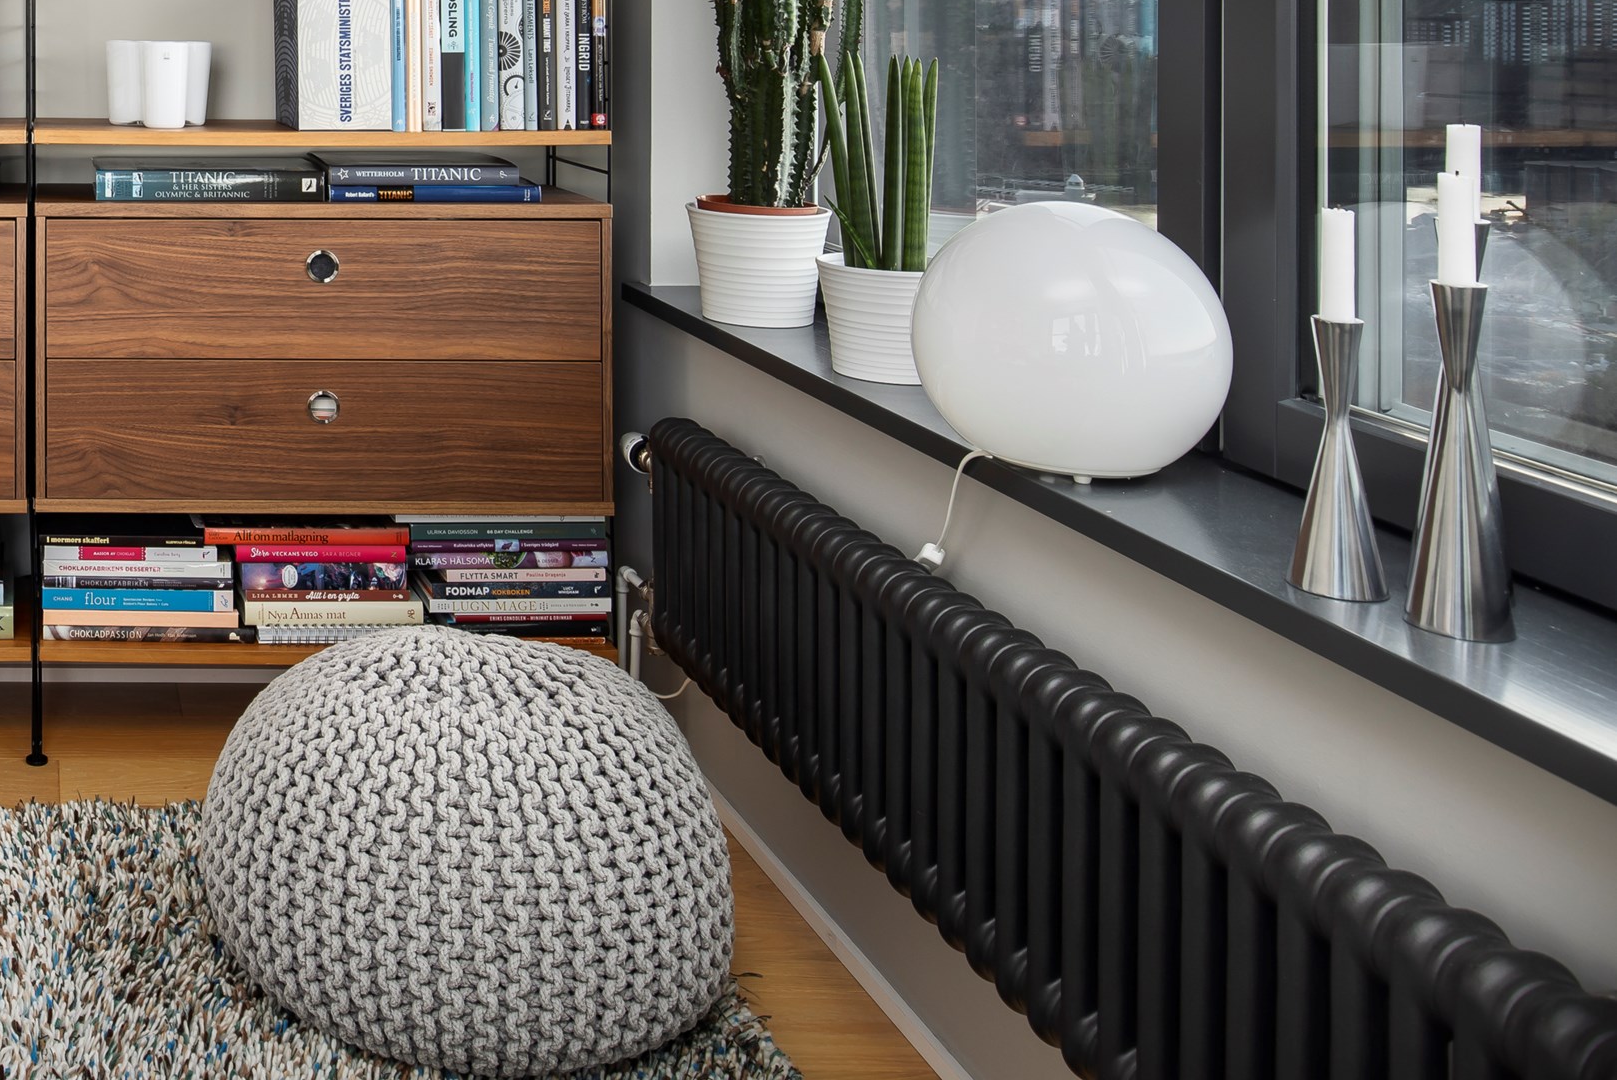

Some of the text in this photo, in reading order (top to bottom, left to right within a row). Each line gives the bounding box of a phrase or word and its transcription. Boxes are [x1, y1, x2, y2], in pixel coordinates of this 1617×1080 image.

[578, 33, 591, 71] INGRID
[339, 74, 352, 123] SVERIGES
[169, 171, 235, 184] TITANIC
[411, 168, 482, 181] TITANIC
[203, 190, 250, 198] BRITANNIC
[378, 190, 413, 199] TITANIC
[233, 531, 329, 544] Allt om matlagning
[415, 555, 495, 566] KLARAS HÄLSOMAT
[80, 579, 149, 587] CHOKLADFABRIKEN
[445, 587, 489, 596] FODMAP
[84, 591, 117, 606] flour
[452, 600, 538, 611] LUGN MAGE
[268, 607, 346, 623] Nya Annas mat
[69, 629, 143, 639] CHOKLADPASSION
